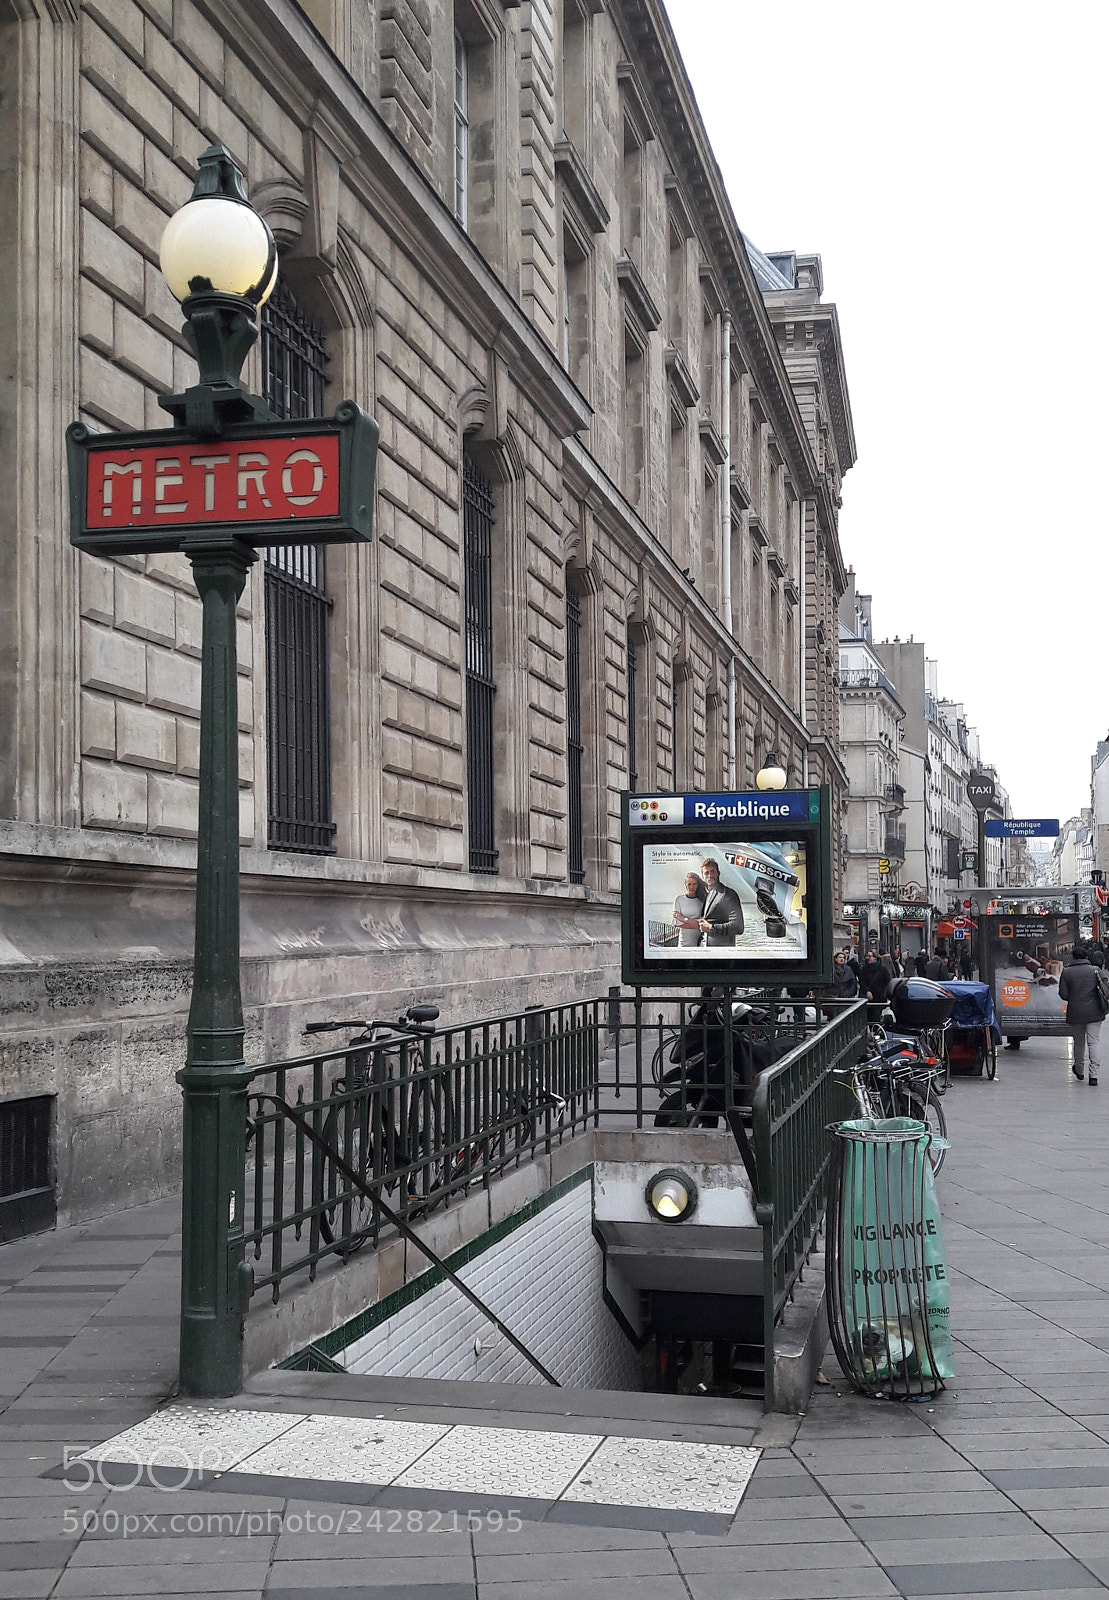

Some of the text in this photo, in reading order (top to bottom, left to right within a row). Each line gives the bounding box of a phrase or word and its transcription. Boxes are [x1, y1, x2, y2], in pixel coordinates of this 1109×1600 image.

[102, 448, 324, 517] METRO
[970, 786, 992, 795] TAXI
[694, 802, 790, 821] République
[1003, 822, 1042, 831] République
[1010, 829, 1035, 837] Temple
[726, 854, 791, 882] T TISSOT
[853, 1219, 937, 1241] VIGLANCE
